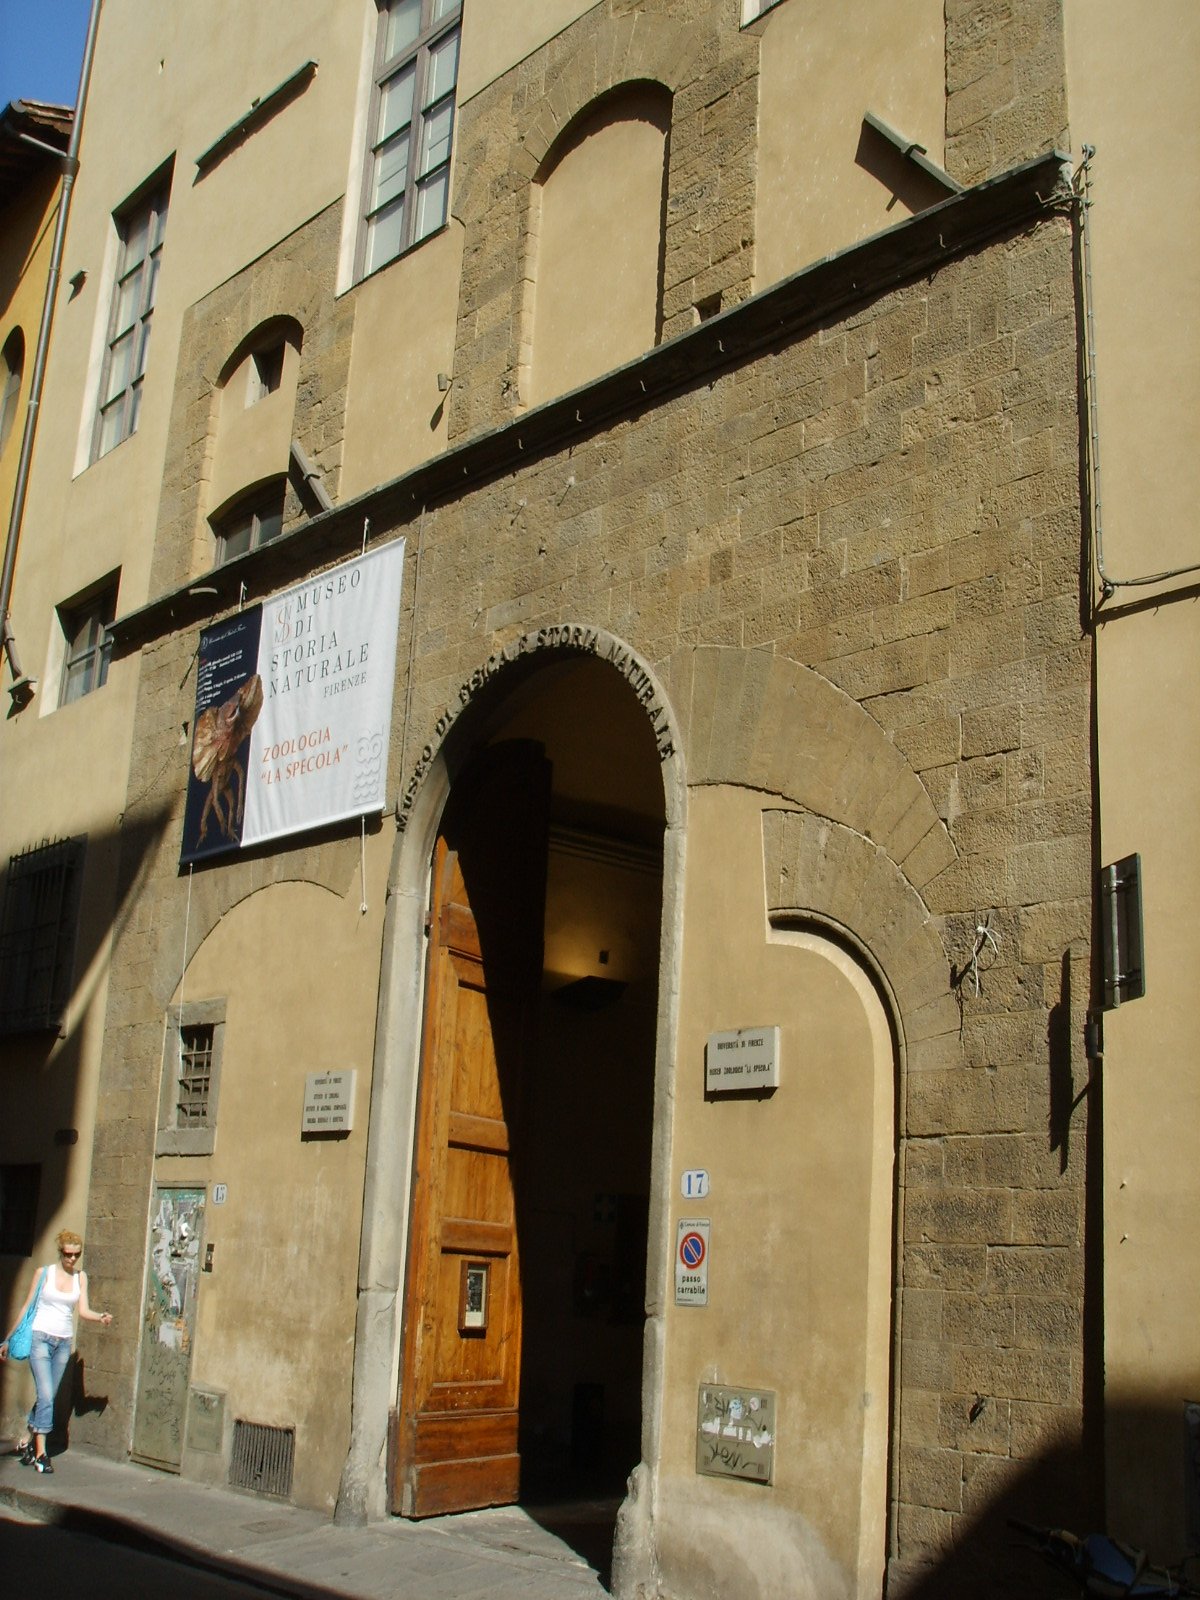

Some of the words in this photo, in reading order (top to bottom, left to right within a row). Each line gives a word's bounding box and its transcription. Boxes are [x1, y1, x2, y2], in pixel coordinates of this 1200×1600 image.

[295, 568, 362, 613] MUSEO
[294, 615, 313, 639] DI
[271, 630, 338, 672] STORIA
[269, 642, 369, 698] NATURALE
[323, 671, 367, 698] FIRENZE
[262, 726, 331, 763] ZOOLOGIA
[396, 743, 433, 833] MUSEO
[536, 624, 601, 654] STORIA
[606, 640, 677, 763] NATURALE
[686, 1173, 704, 1195] 17
[676, 1285, 706, 1295] carrabile
[681, 1274, 701, 1284] passo
